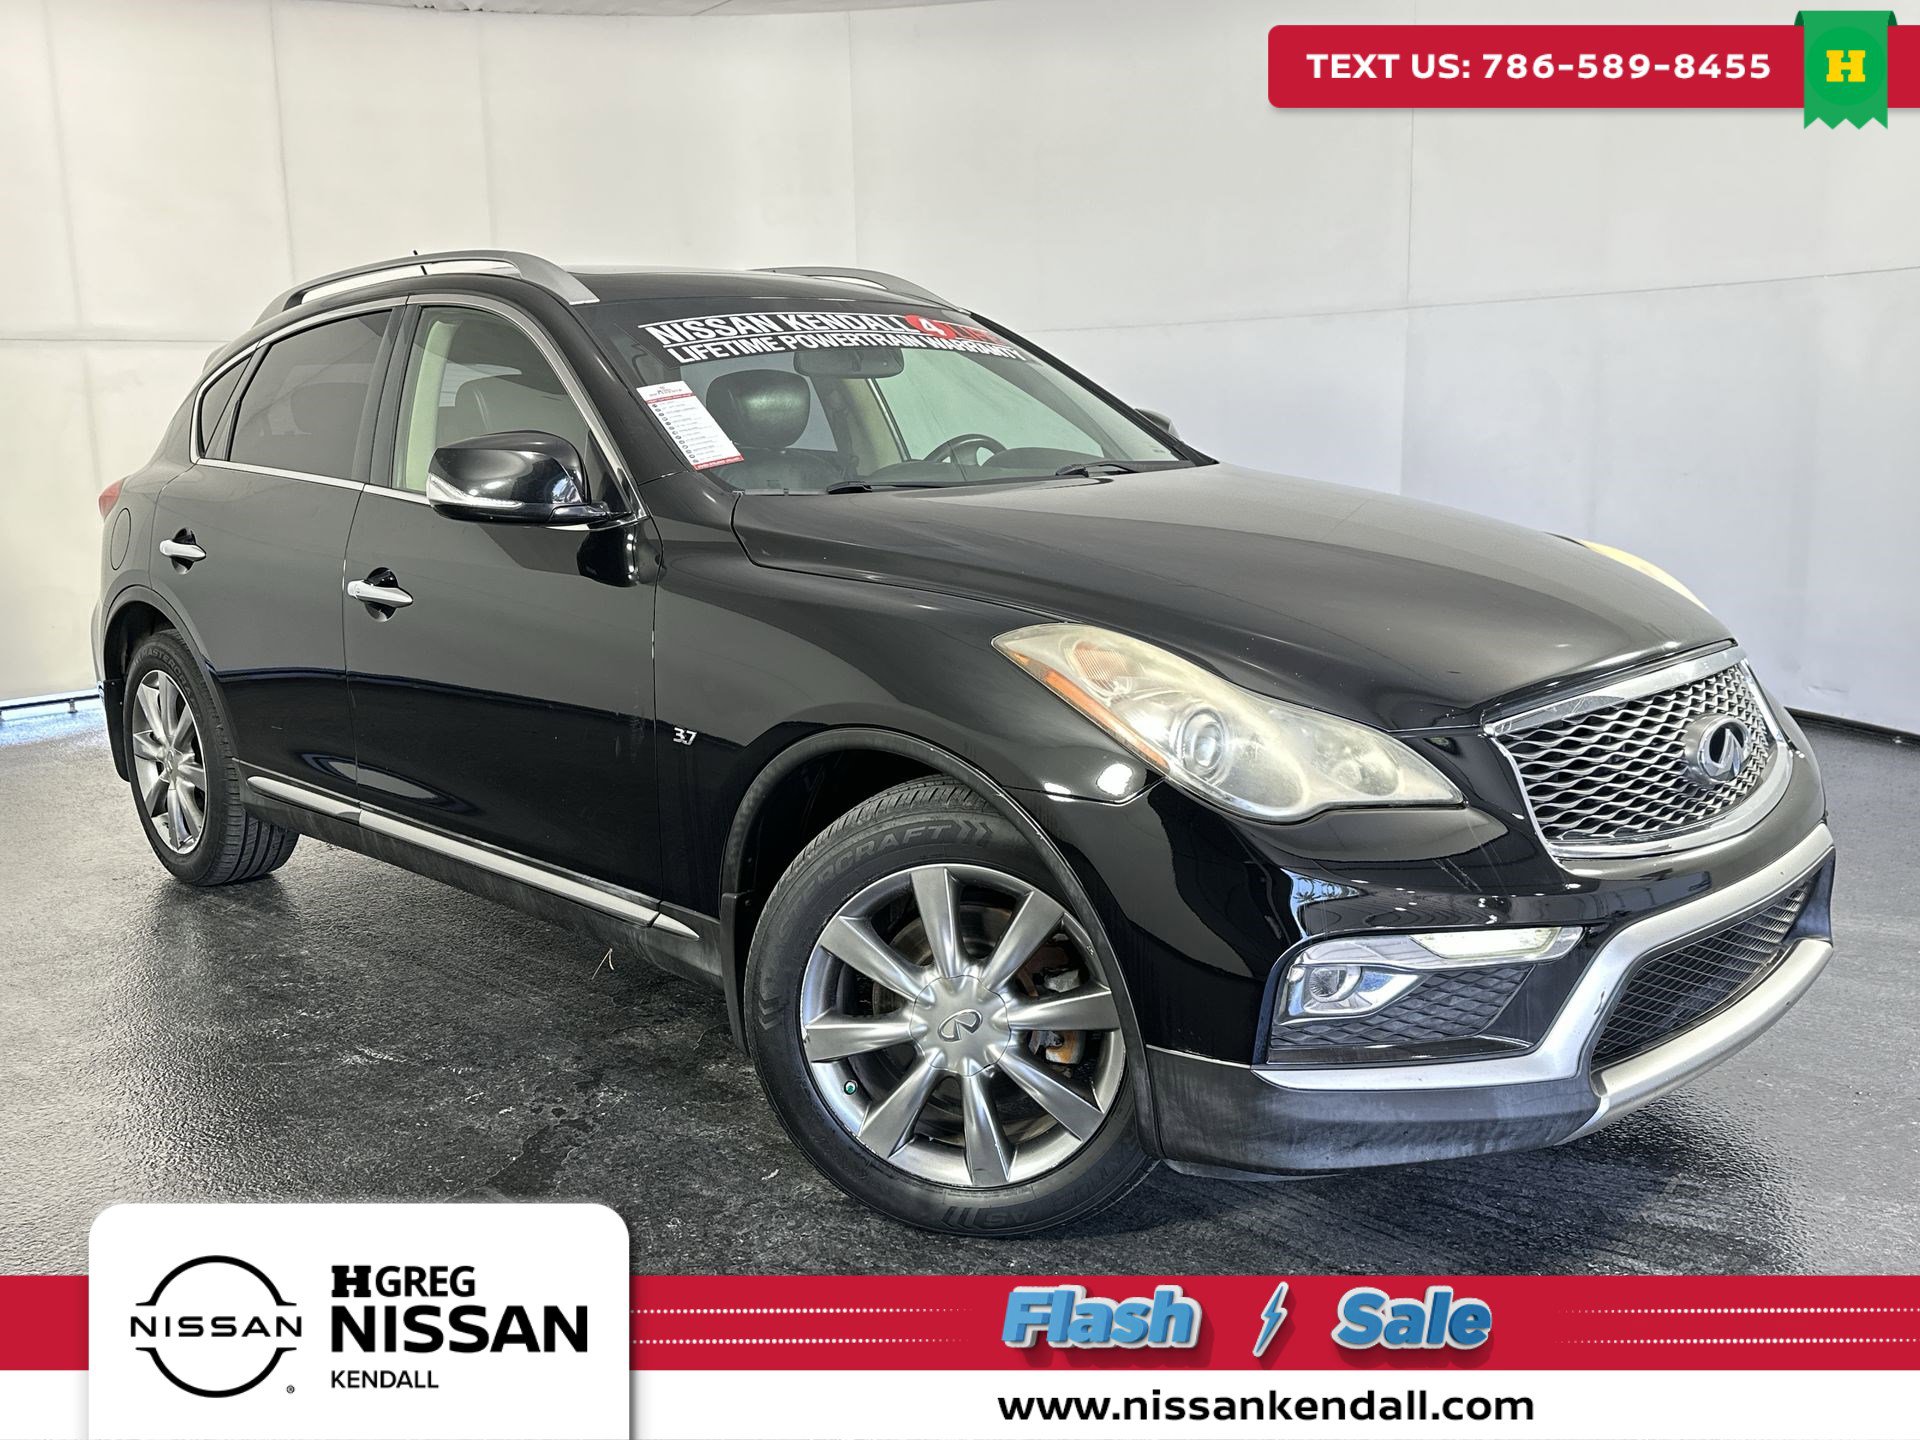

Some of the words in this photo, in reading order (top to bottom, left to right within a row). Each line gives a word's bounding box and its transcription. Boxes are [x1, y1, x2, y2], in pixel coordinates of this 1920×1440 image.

[644, 315, 785, 345] NISSAN
[777, 314, 920, 333] KENDALL
[919, 319, 945, 336] 4
[666, 335, 786, 364] LIFETIME
[778, 331, 921, 350] POWERTRAIN
[919, 337, 1027, 361] WARRANTY
